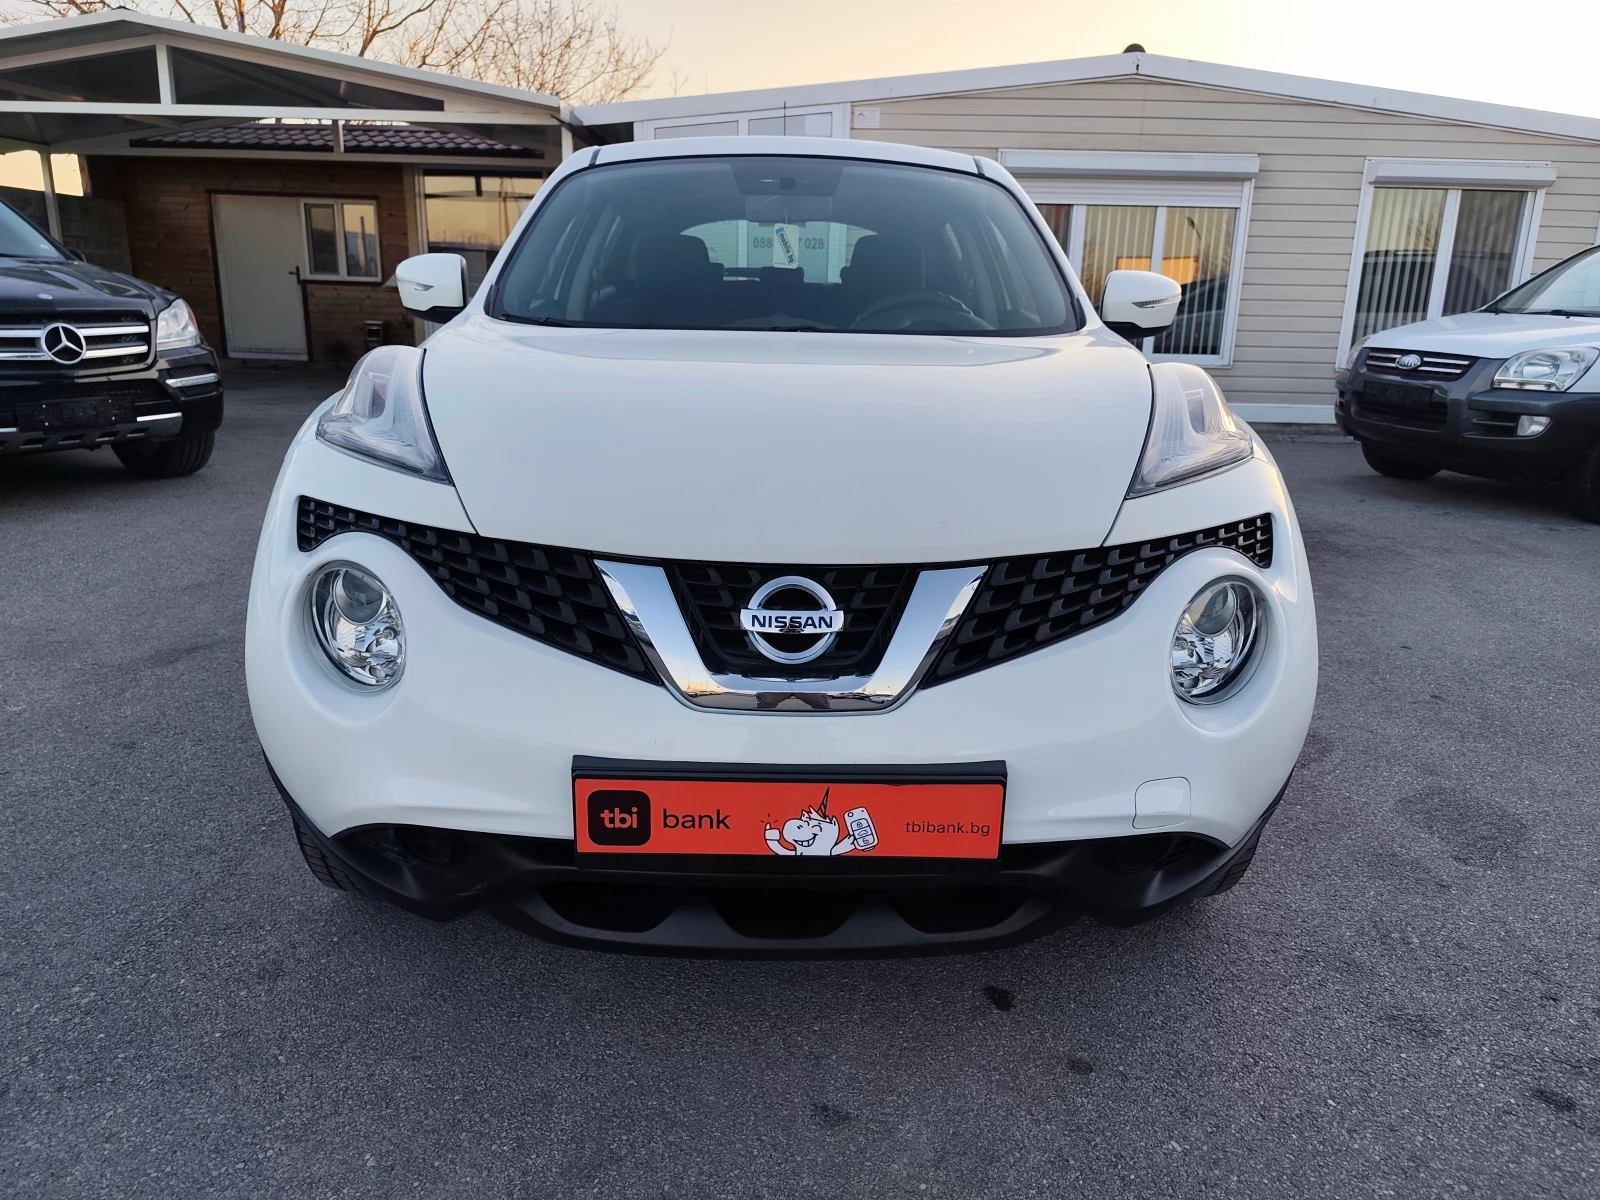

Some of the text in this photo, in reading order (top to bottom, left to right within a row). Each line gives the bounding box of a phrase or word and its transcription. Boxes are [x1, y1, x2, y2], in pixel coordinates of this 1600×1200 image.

[753, 236, 774, 249] 088
[804, 238, 825, 250] 028
[779, 233, 796, 265] mobile.bg
[751, 614, 833, 629] NISSAN
[600, 807, 731, 830] tbi bank
[905, 820, 991, 837] tbibank.bg
